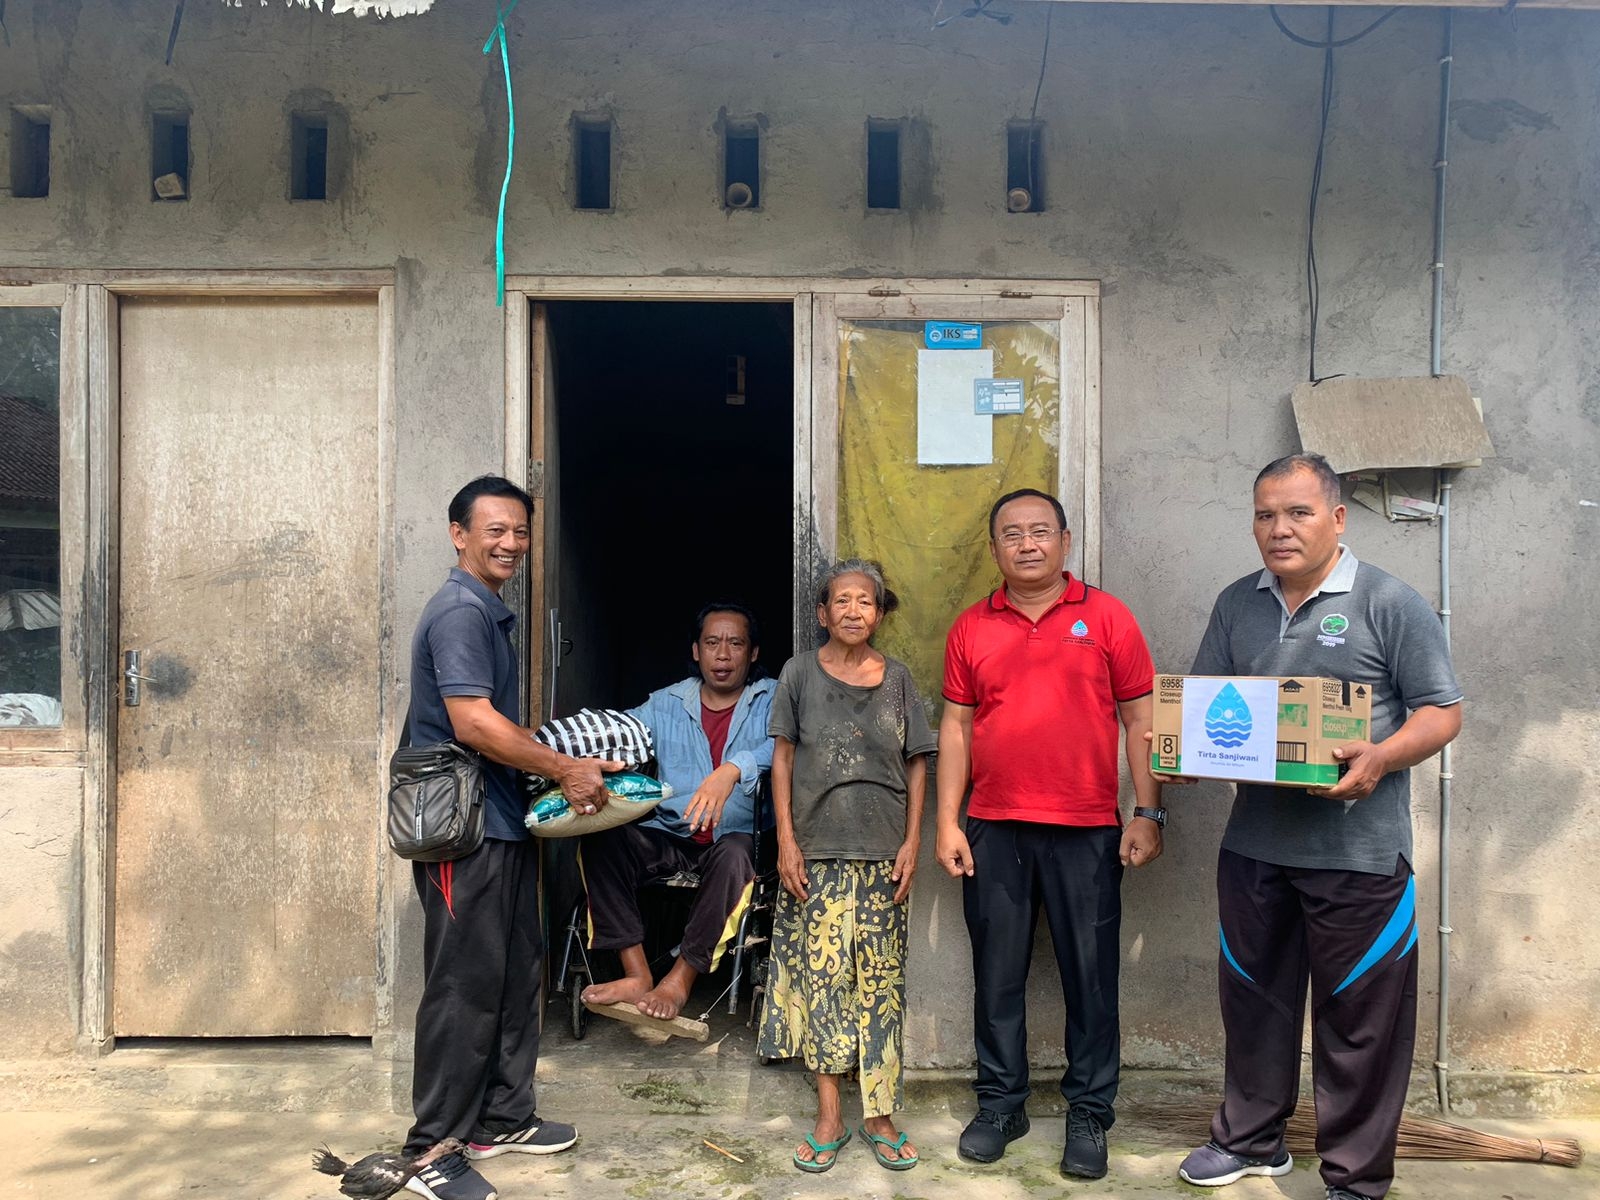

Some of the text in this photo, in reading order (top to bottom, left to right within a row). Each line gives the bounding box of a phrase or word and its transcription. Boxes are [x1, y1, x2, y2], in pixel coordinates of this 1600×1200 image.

[943, 328, 961, 339] IKS
[1163, 737, 1173, 754] 8
[1197, 750, 1259, 762] Tirta Sanjiwani
